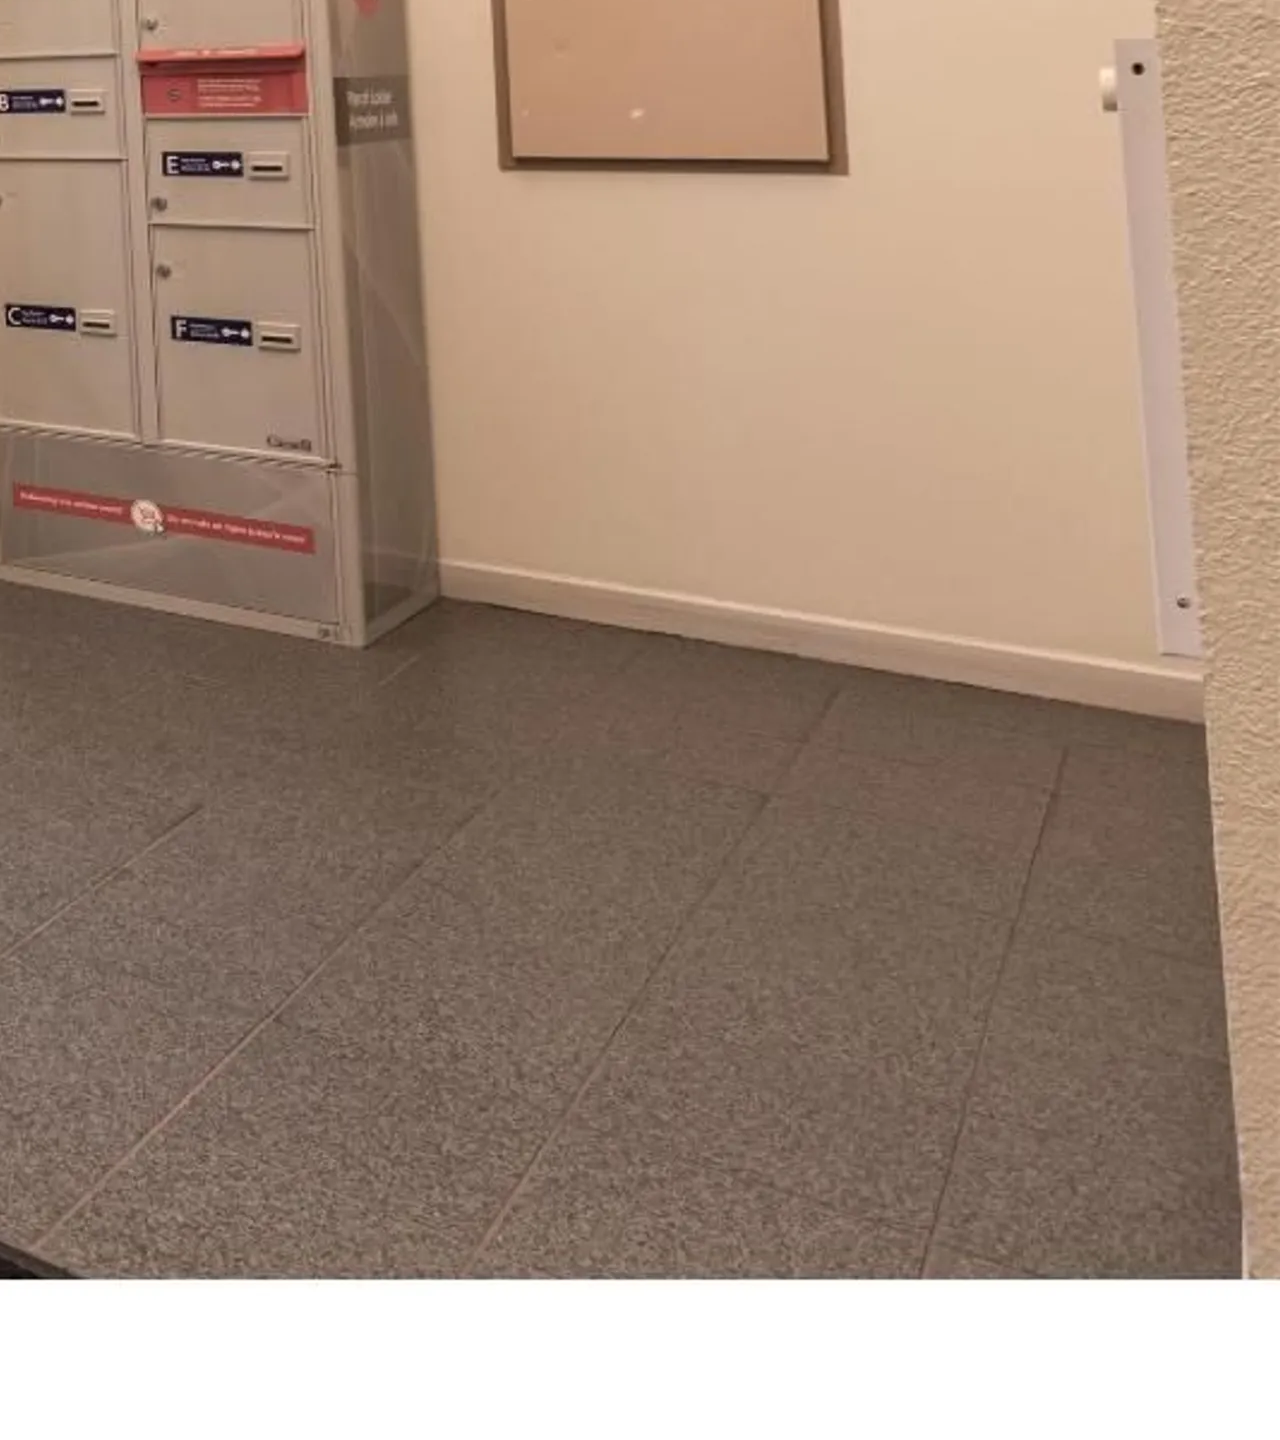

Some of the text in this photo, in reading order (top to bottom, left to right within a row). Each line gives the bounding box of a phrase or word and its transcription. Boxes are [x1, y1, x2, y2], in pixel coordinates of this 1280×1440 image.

[166, 155, 180, 175] E
[7, 306, 22, 325] C
[175, 319, 188, 338] F
